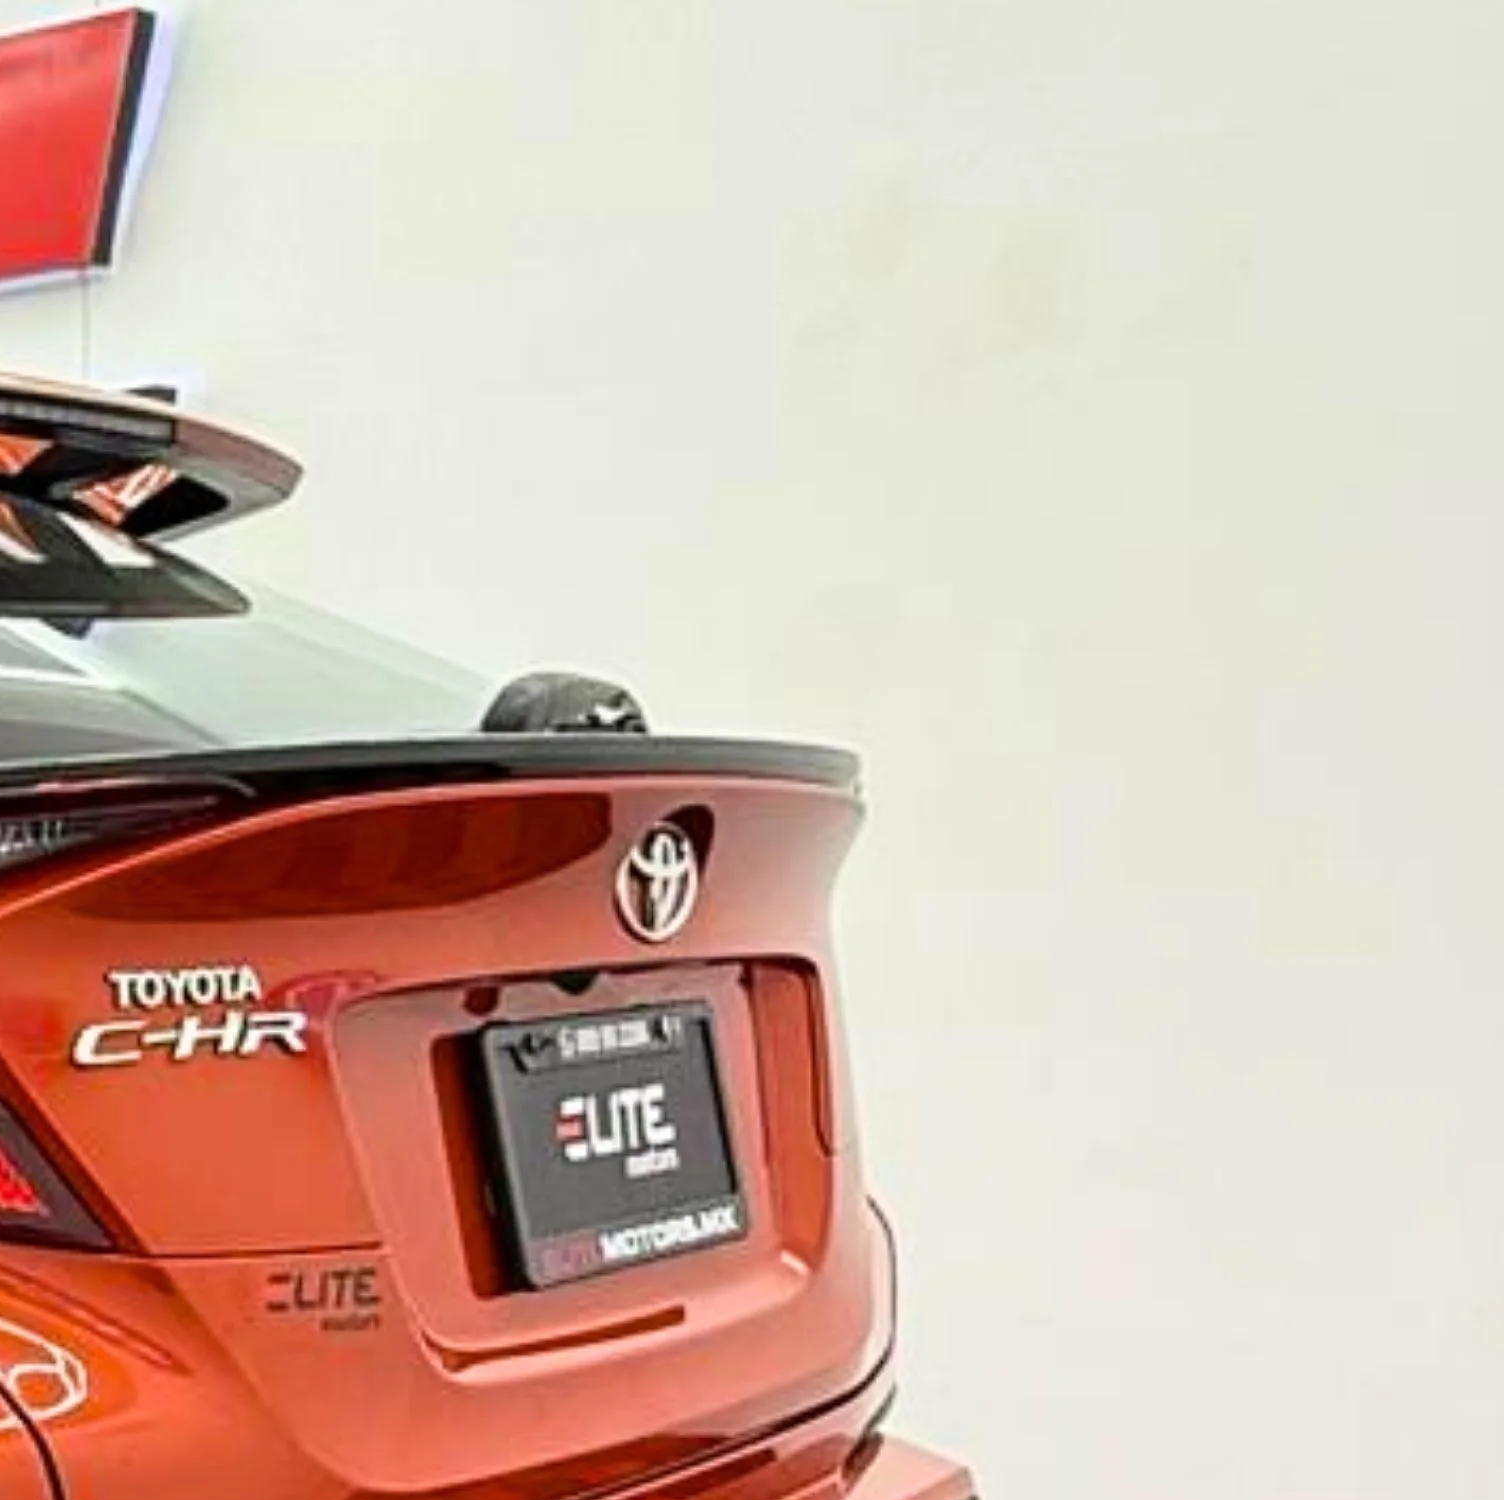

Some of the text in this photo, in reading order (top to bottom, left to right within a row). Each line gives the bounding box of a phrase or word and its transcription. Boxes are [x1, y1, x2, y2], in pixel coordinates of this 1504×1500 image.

[107, 964, 261, 1009] TOYOTA
[71, 1010, 308, 1065] C-HR
[555, 1083, 676, 1162] ELITE
